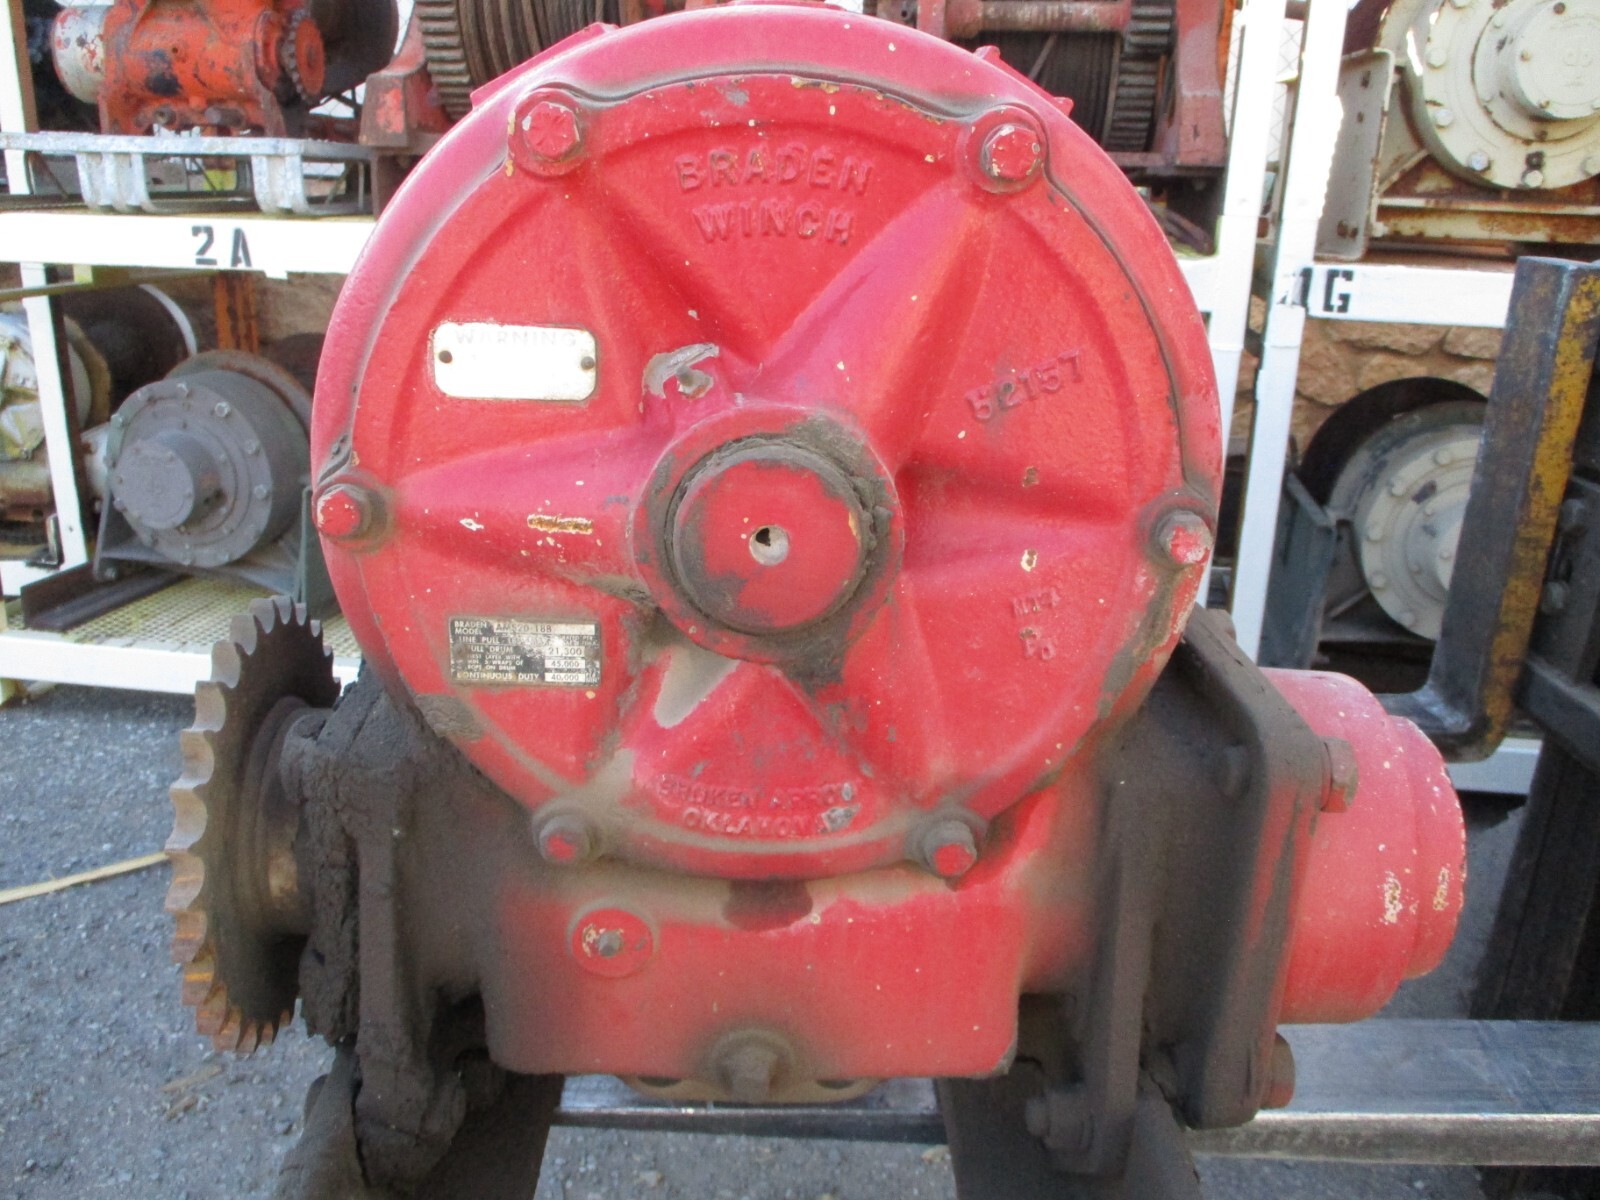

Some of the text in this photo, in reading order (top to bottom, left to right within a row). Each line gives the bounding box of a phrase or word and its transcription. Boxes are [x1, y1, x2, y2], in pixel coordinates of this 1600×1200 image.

[674, 142, 873, 196] BRADEN
[692, 198, 854, 246] WINCH
[454, 327, 577, 348] WARNING
[964, 350, 1081, 420] 52157
[454, 620, 487, 629] BRADEN
[481, 636, 500, 644] PULL
[489, 645, 513, 653] DRUM
[518, 673, 539, 681] DUTY
